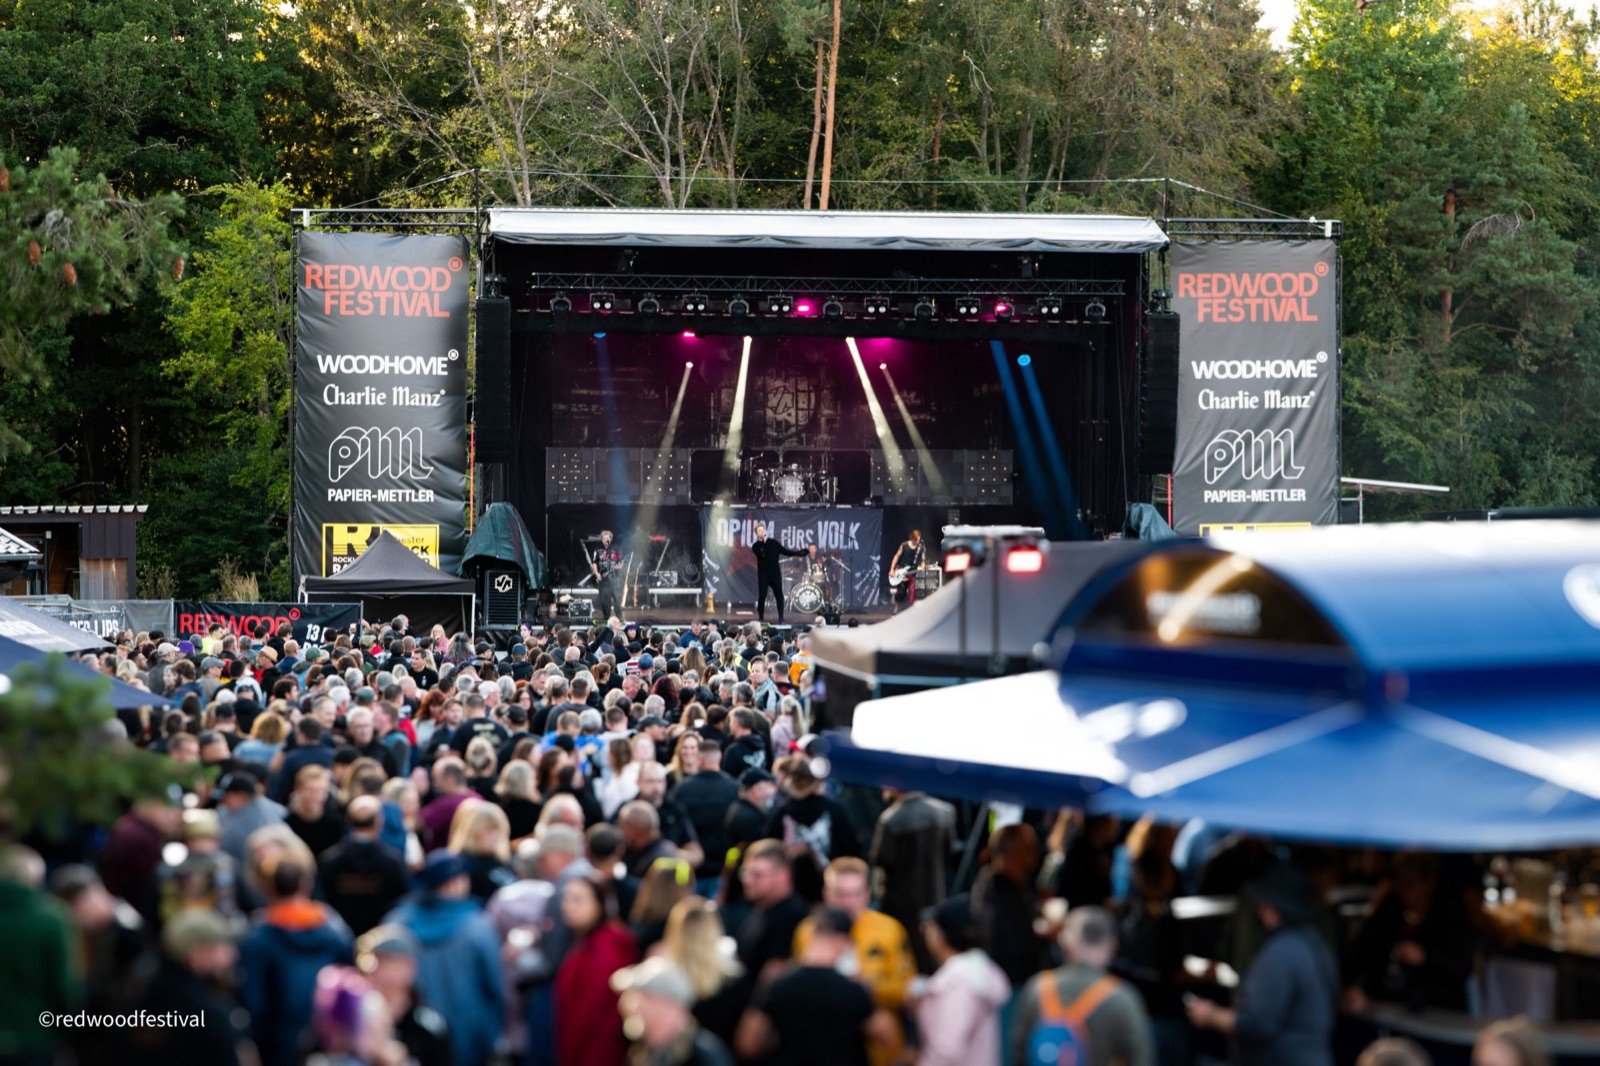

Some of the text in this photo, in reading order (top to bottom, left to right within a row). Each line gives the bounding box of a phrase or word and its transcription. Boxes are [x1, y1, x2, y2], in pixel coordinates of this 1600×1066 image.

[305, 263, 451, 293] REDWOOD
[1178, 272, 1319, 298] REDWOOD
[324, 291, 450, 317] FESTIVAL
[1197, 298, 1318, 323] FESTIVAL
[317, 354, 449, 376] WOODHOME
[1191, 359, 1318, 379] WOODHOME
[323, 383, 442, 407] Charlie Manz
[1198, 388, 1312, 410] Charlie Manz
[327, 488, 435, 502] PAPIER-METTLER
[1203, 489, 1306, 503] PAPIER-METTLER
[817, 520, 861, 550] VOLK
[306, 623, 320, 641] 13
